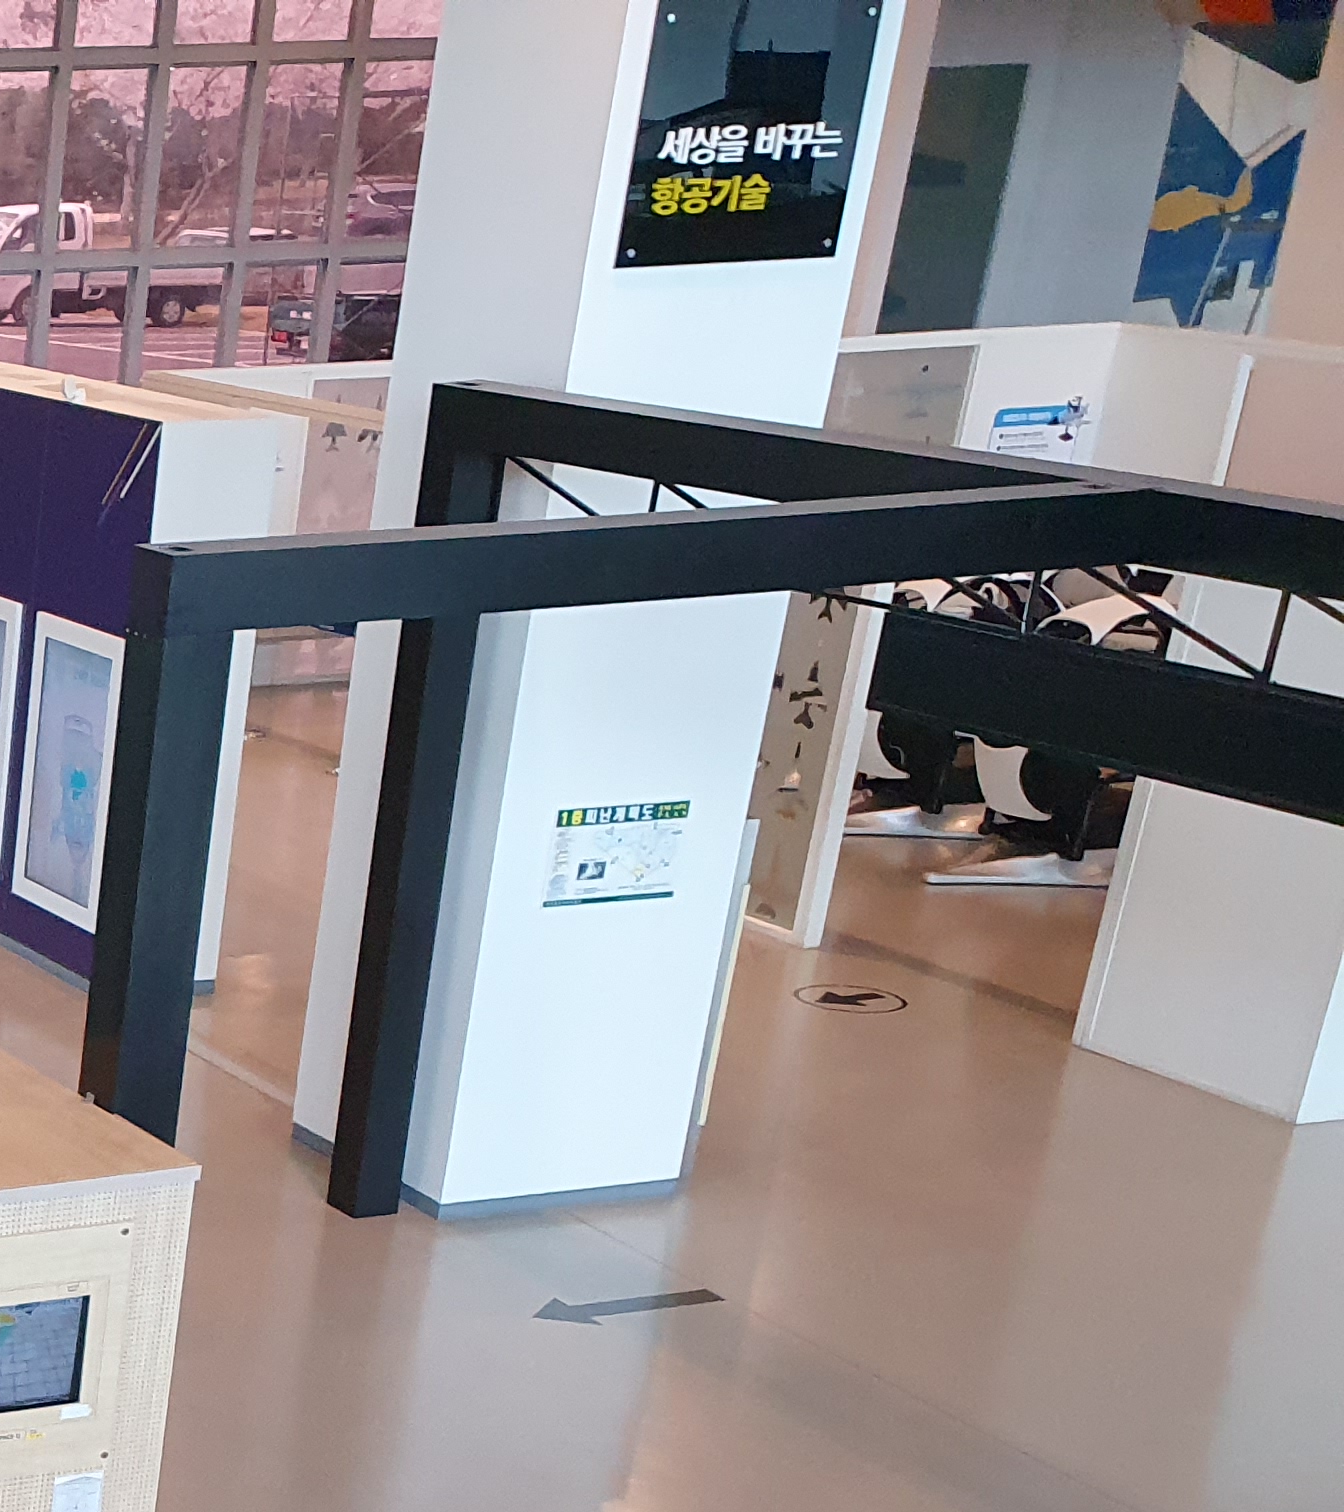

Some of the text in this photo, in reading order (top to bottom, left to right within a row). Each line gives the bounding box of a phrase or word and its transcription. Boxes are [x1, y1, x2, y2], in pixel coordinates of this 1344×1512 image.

[657, 121, 844, 165] 세상을 바꾸는
[650, 173, 772, 216] 항공기술
